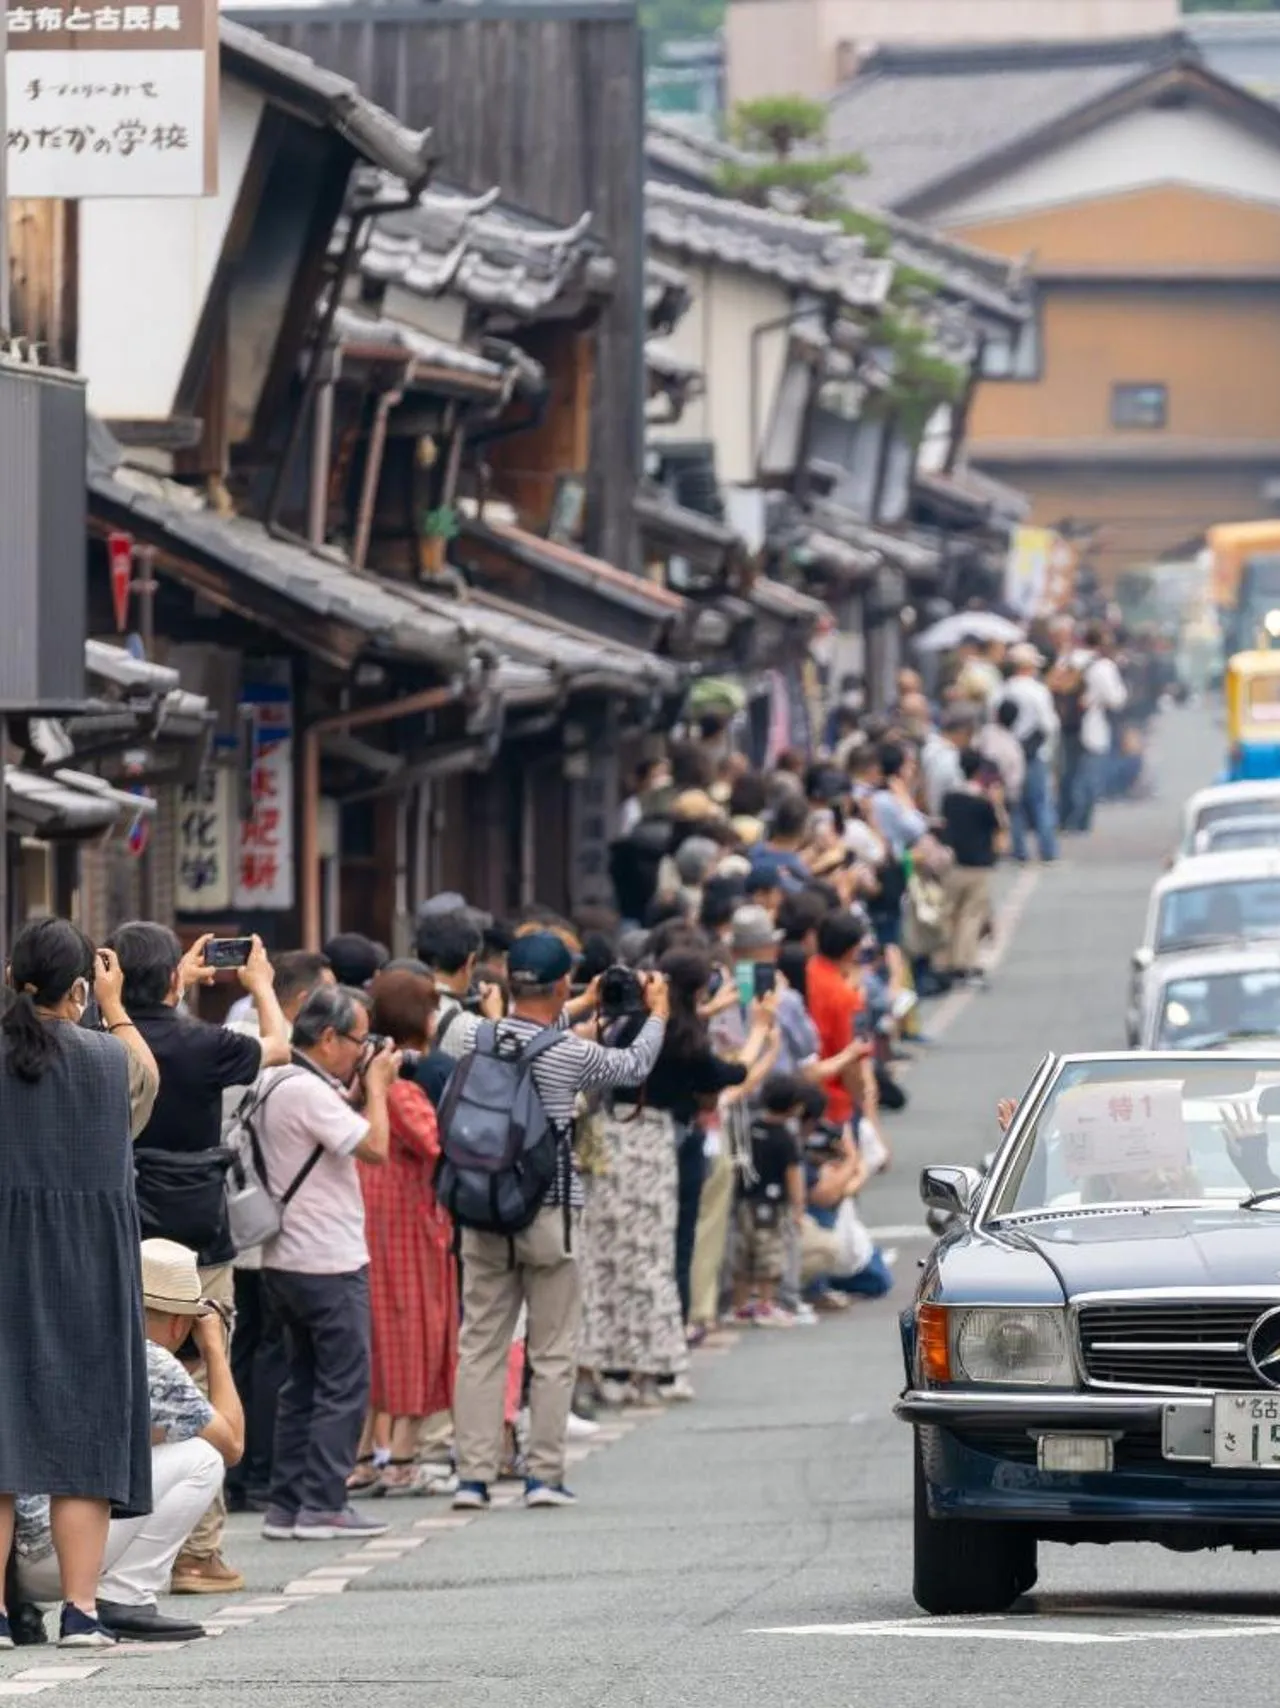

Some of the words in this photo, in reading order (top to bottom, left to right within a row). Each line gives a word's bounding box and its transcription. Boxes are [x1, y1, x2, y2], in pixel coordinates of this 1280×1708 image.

[5, 6, 181, 31] 古布と古民具
[6, 118, 188, 156] めだかの学校
[1224, 1432, 1237, 1452] さ
